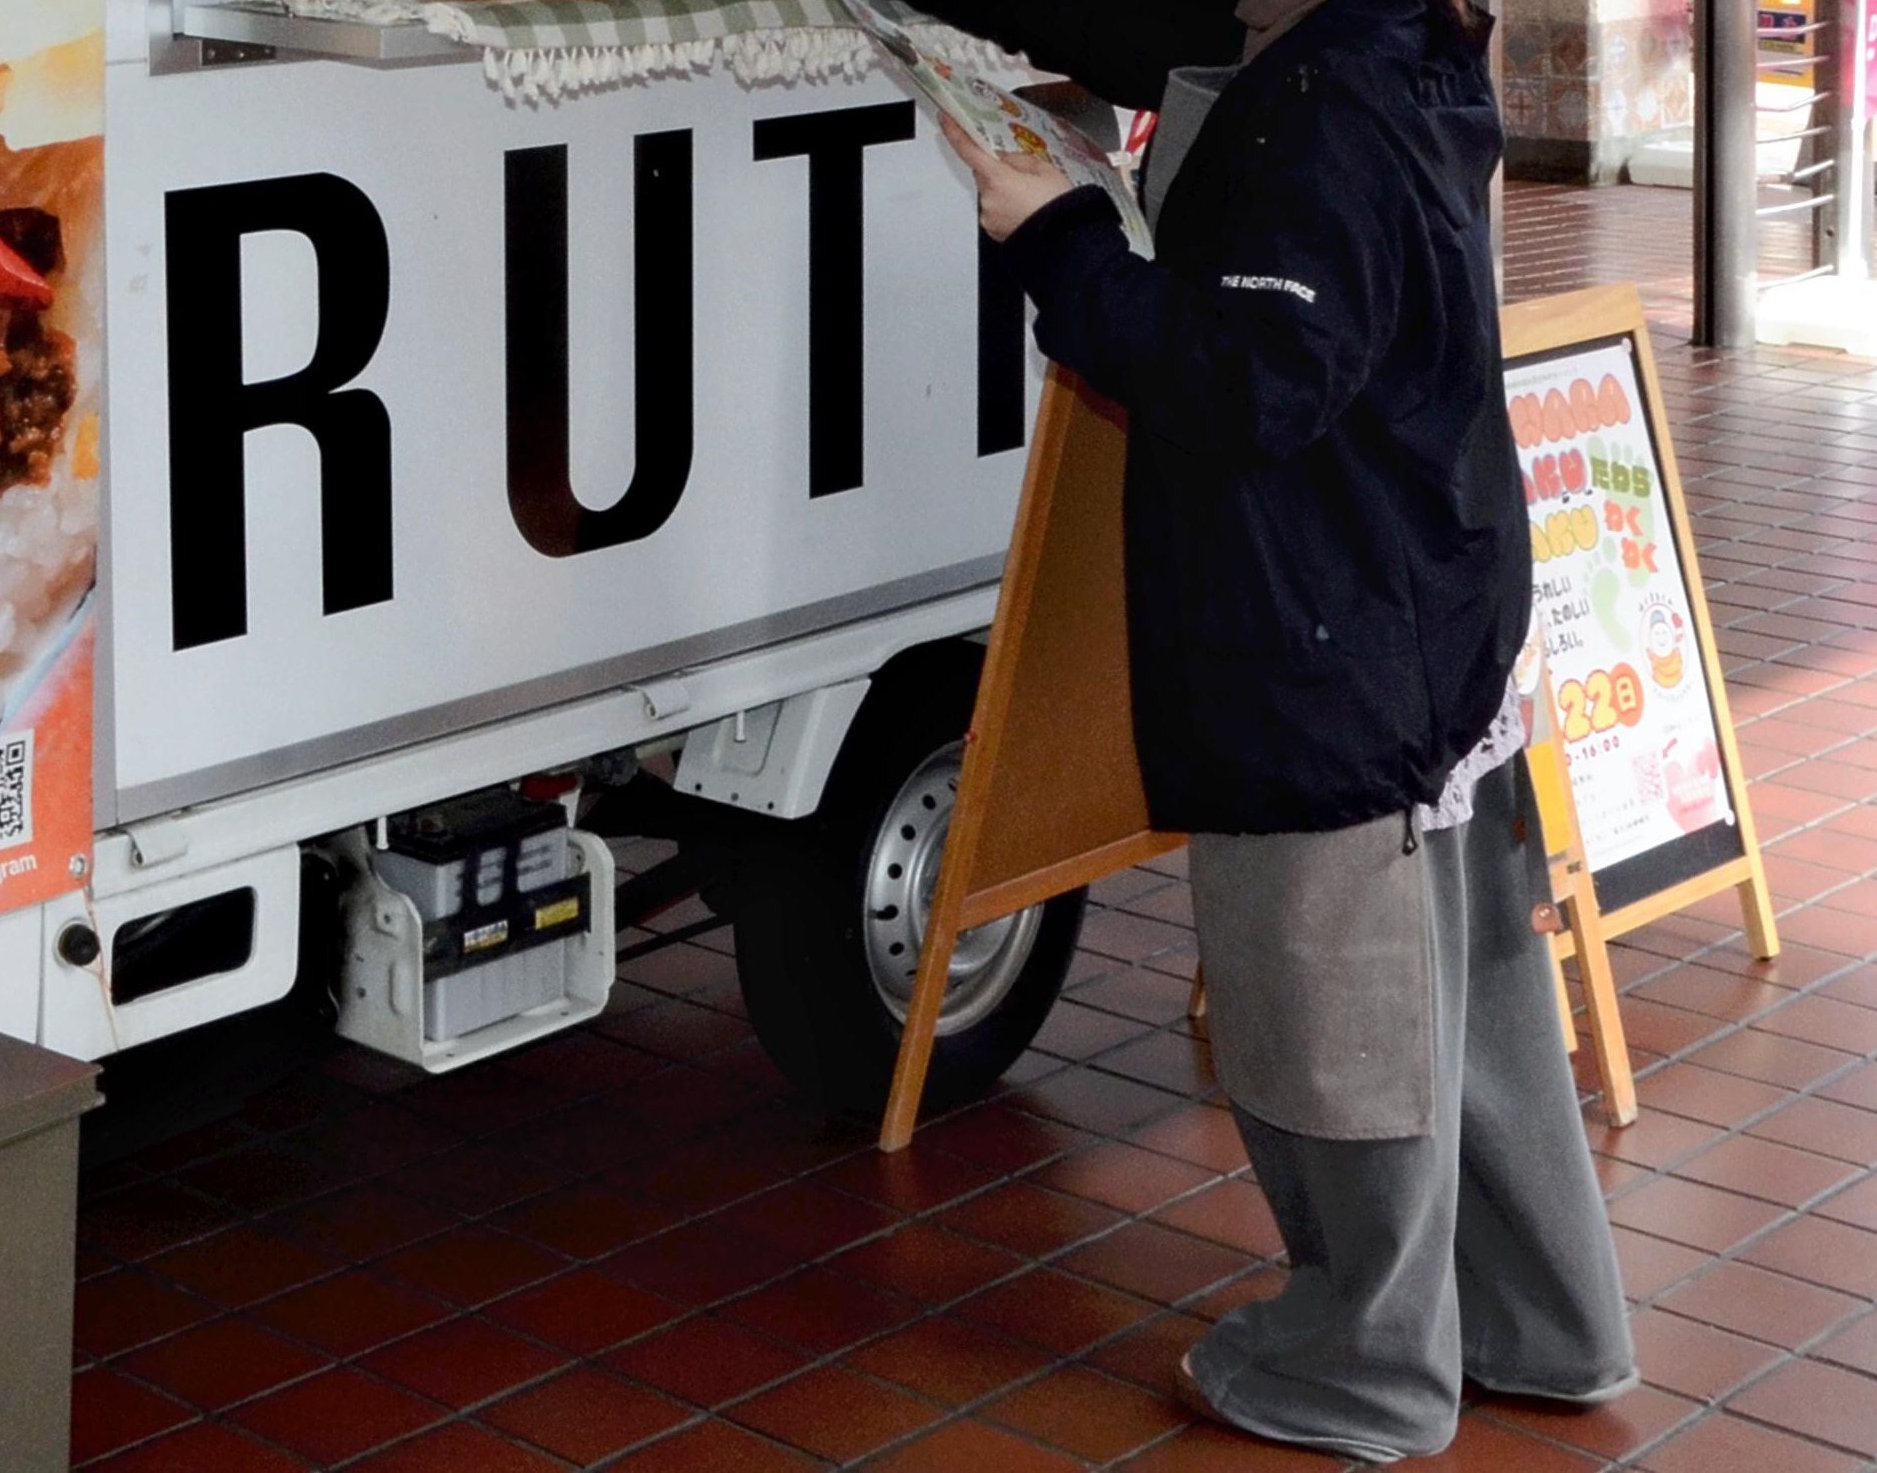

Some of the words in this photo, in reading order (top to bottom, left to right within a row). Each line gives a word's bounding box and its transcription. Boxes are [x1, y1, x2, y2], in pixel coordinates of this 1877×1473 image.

[1221, 275, 1241, 288] THE
[1241, 276, 1283, 291] NORTH
[1283, 279, 1317, 304] FACE
